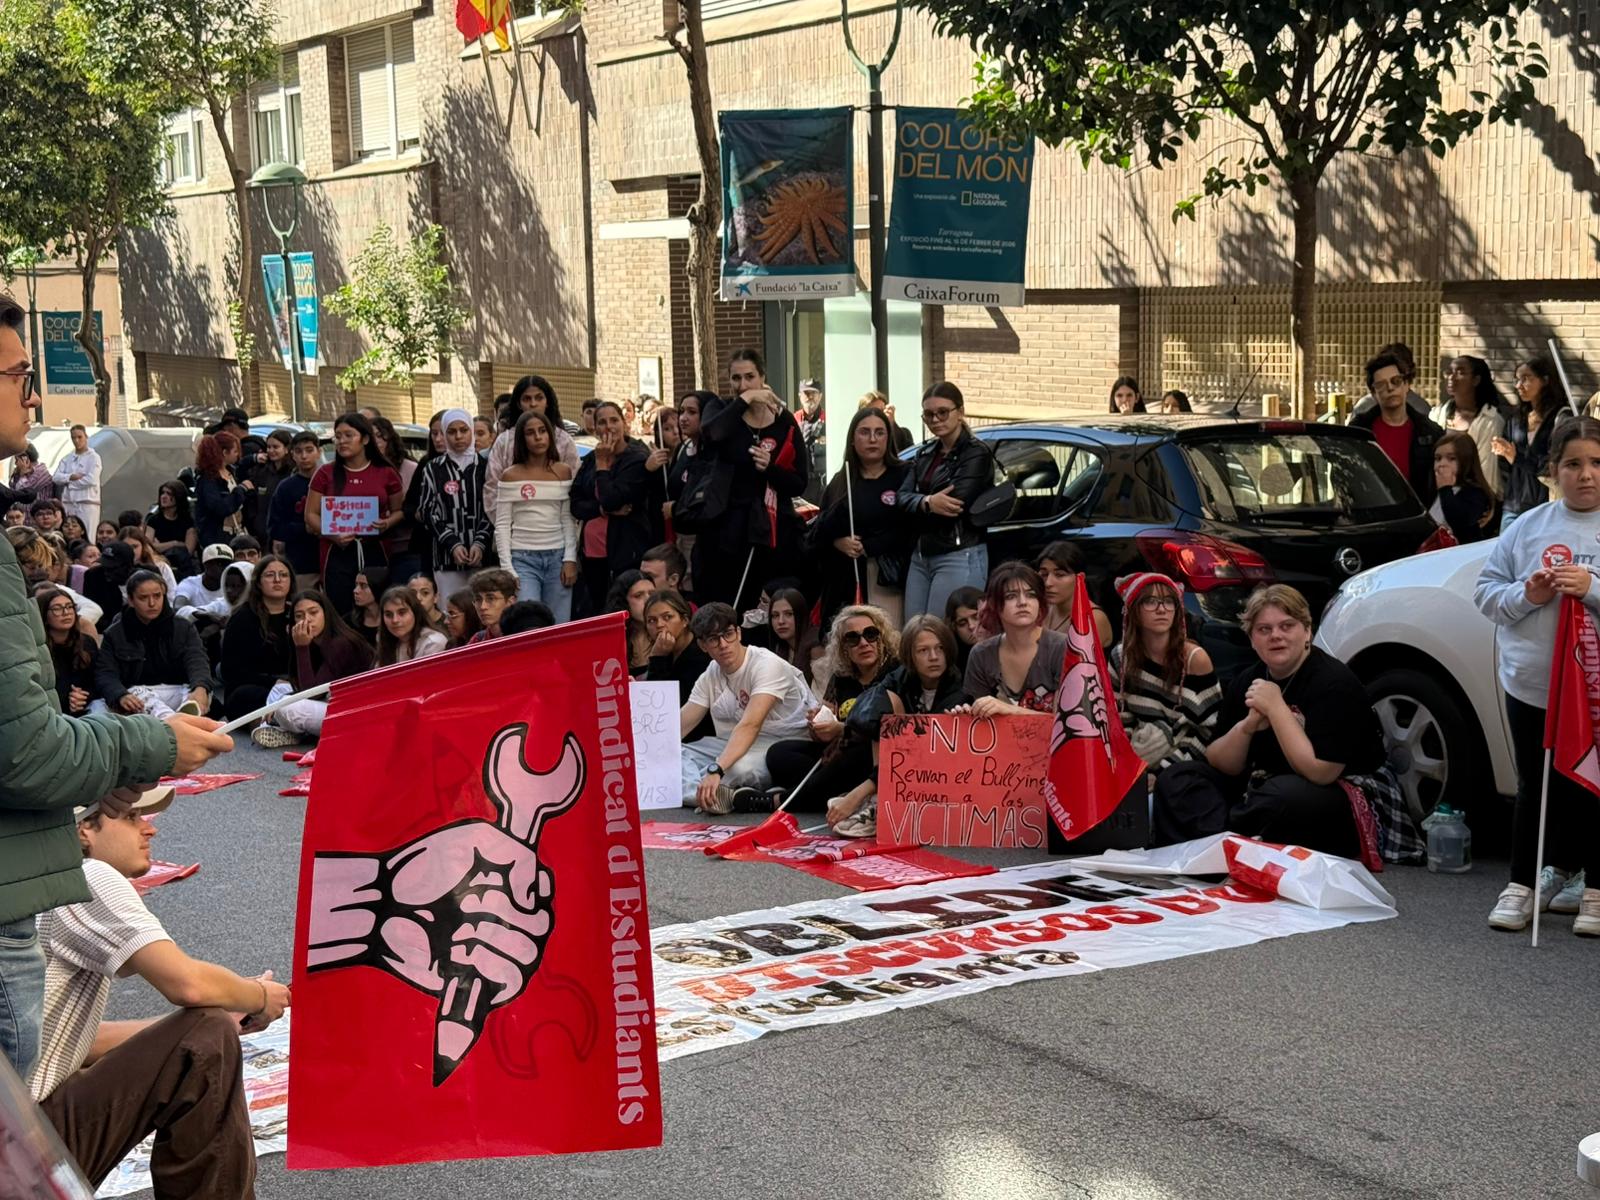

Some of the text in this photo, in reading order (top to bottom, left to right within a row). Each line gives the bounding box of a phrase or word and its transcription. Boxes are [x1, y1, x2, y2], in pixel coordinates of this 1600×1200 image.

[899, 152, 1028, 183] DEL MÓN
[972, 199, 1008, 207] GEOGRAPHIC
[973, 192, 1000, 200] NATIONAL
[755, 282, 797, 293] Fundació
[904, 283, 1000, 303] CaixaForum
[44, 317, 98, 330] COLOS
[46, 330, 68, 342] DEL
[1573, 554, 1596, 566] RTY
[637, 689, 666, 709] SU
[632, 712, 669, 735] BRE
[930, 716, 997, 755] NO
[890, 752, 948, 784] Revivan
[954, 769, 973, 784] el
[895, 781, 1023, 808] Revivan a las
[885, 801, 1045, 849] VICTIMAS
[592, 657, 650, 1125] Sindicat d'Estudiants
[675, 904, 1164, 1004] DISCURSOS
